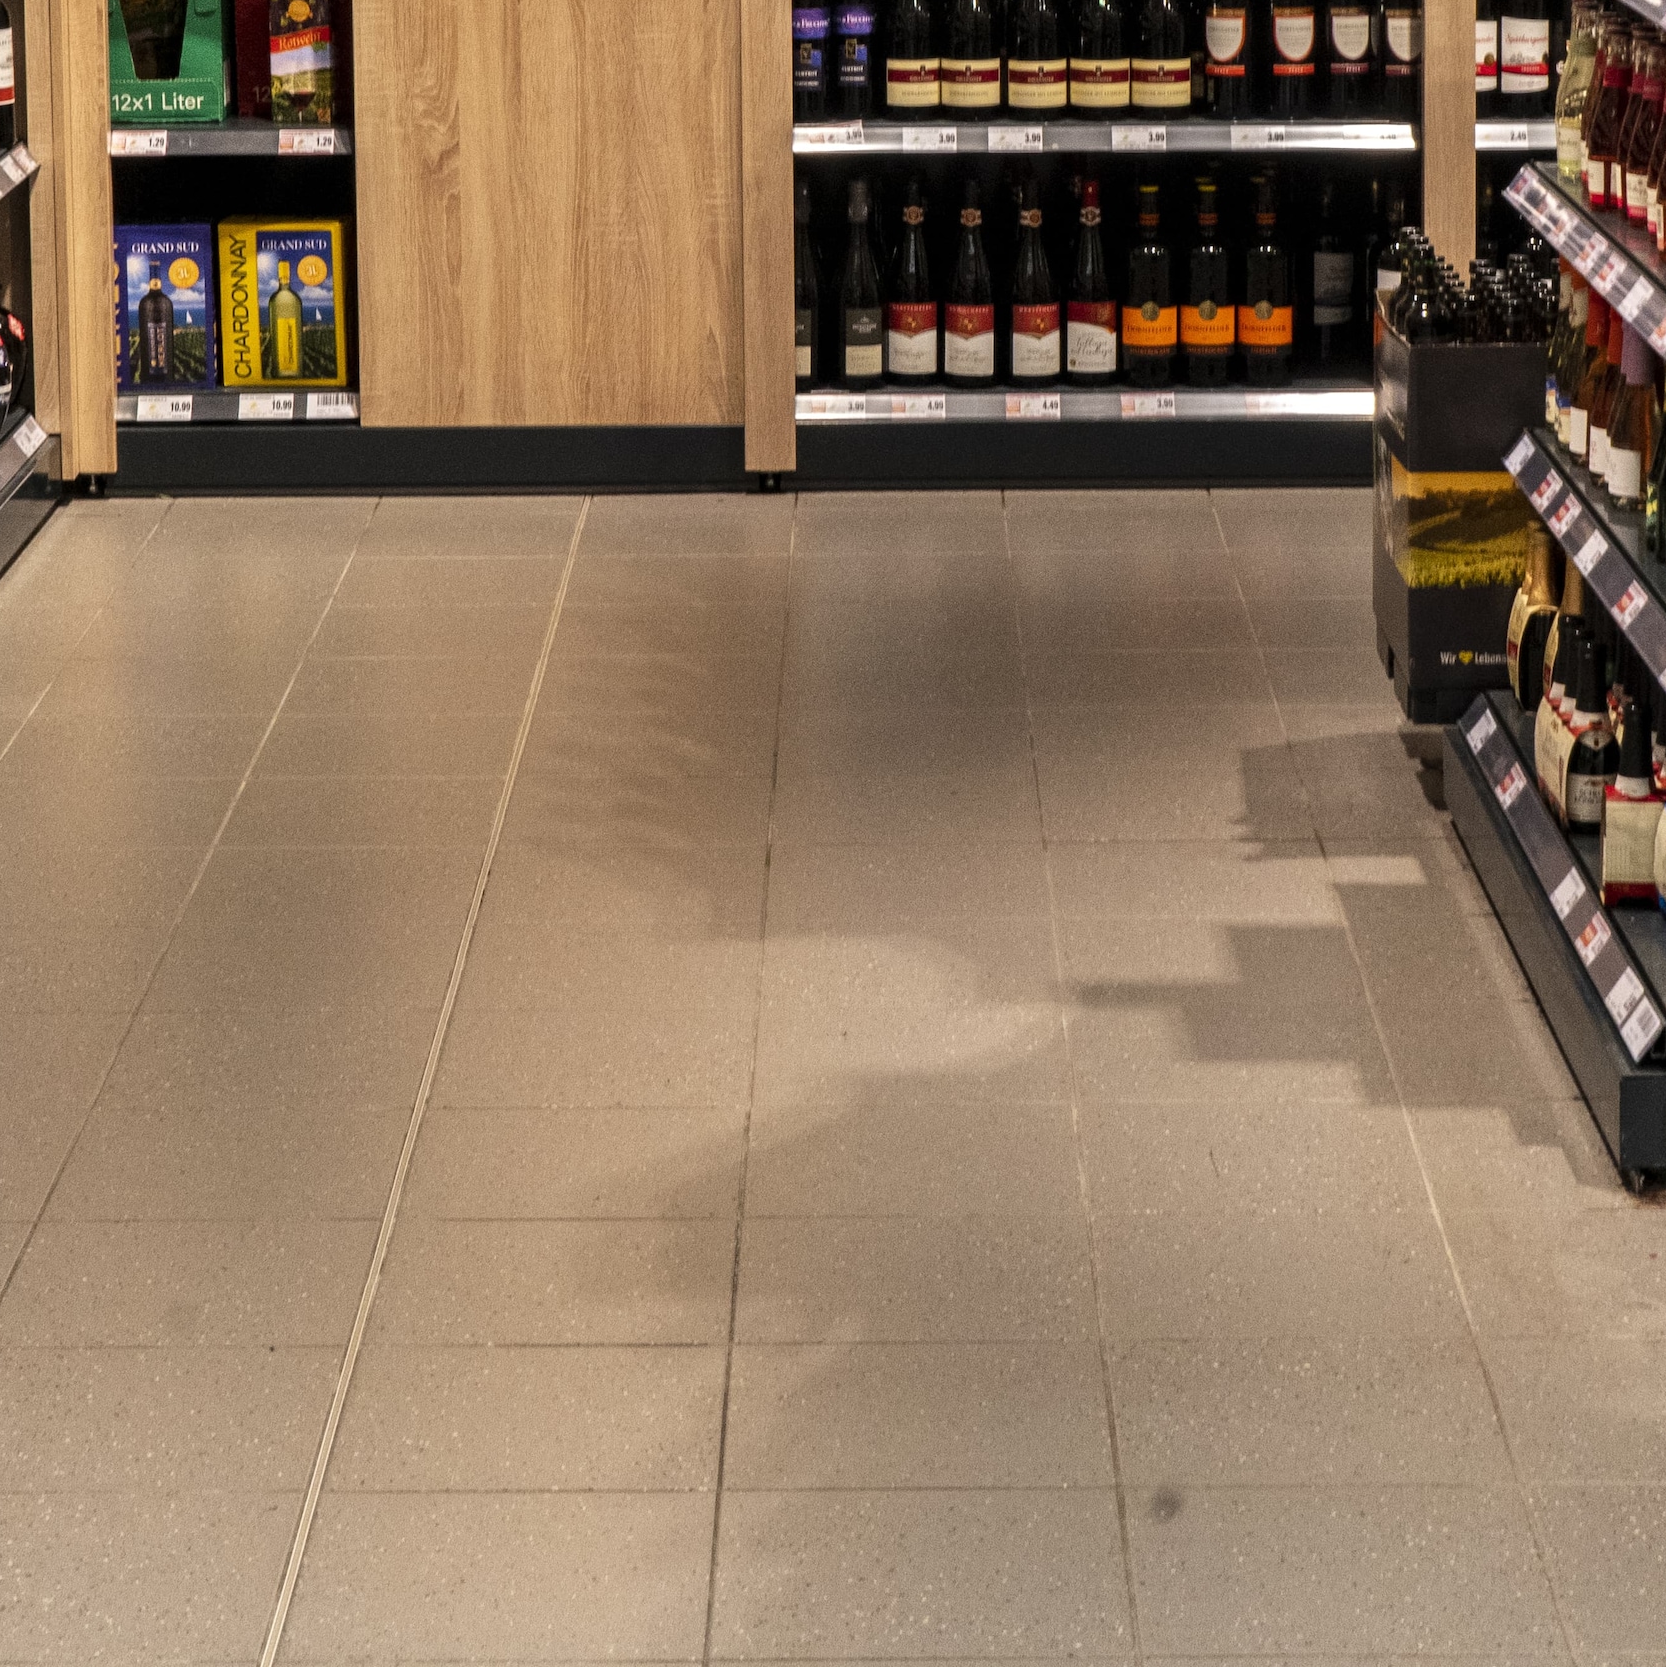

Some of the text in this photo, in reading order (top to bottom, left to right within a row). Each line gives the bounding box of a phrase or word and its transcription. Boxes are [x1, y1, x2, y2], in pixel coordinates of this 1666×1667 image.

[111, 92, 204, 113] 12x1 Liter
[131, 240, 199, 254] GRAND SUD
[262, 238, 327, 252] GRAND SUD
[229, 233, 253, 379] CHARDONNAY
[170, 402, 191, 413] 10.99
[272, 400, 292, 411] 10.99
[1440, 652, 1456, 664] Wir
